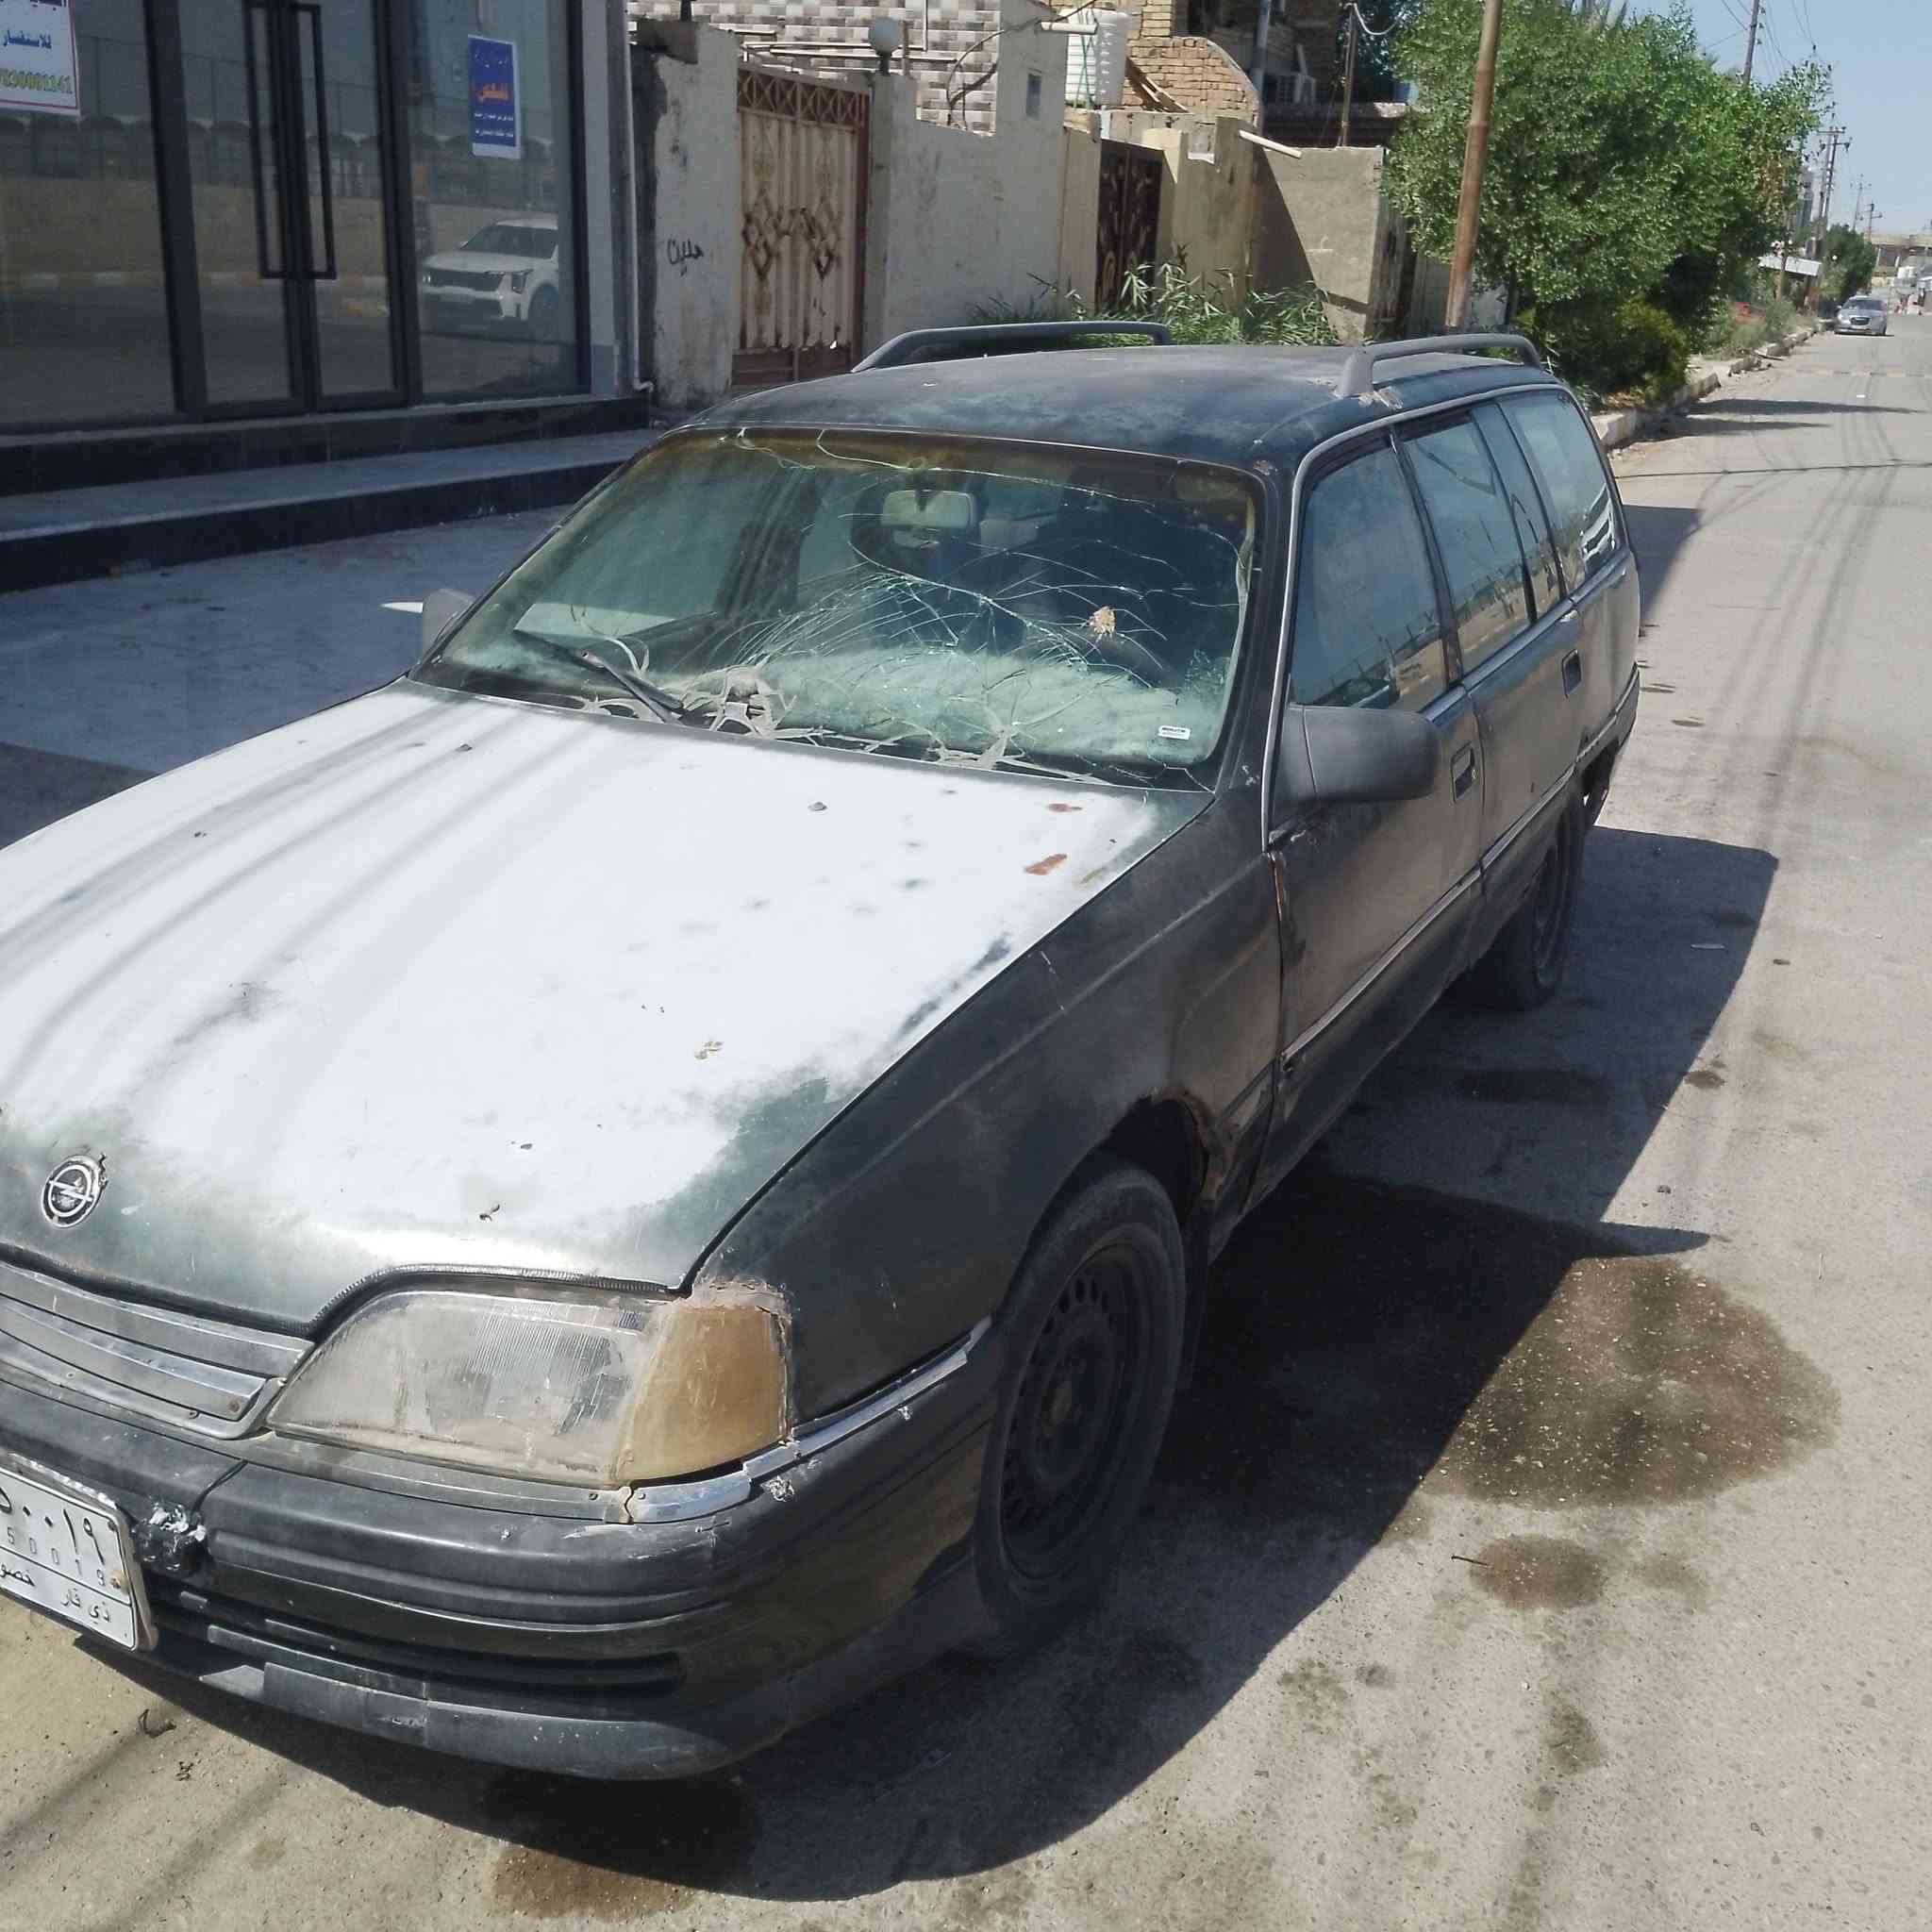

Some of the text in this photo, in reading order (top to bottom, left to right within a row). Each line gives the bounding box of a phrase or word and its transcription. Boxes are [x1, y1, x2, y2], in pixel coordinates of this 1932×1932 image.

[7, 1525, 106, 1587] 50019
[0, 1563, 111, 1624] ذي قار خصو
